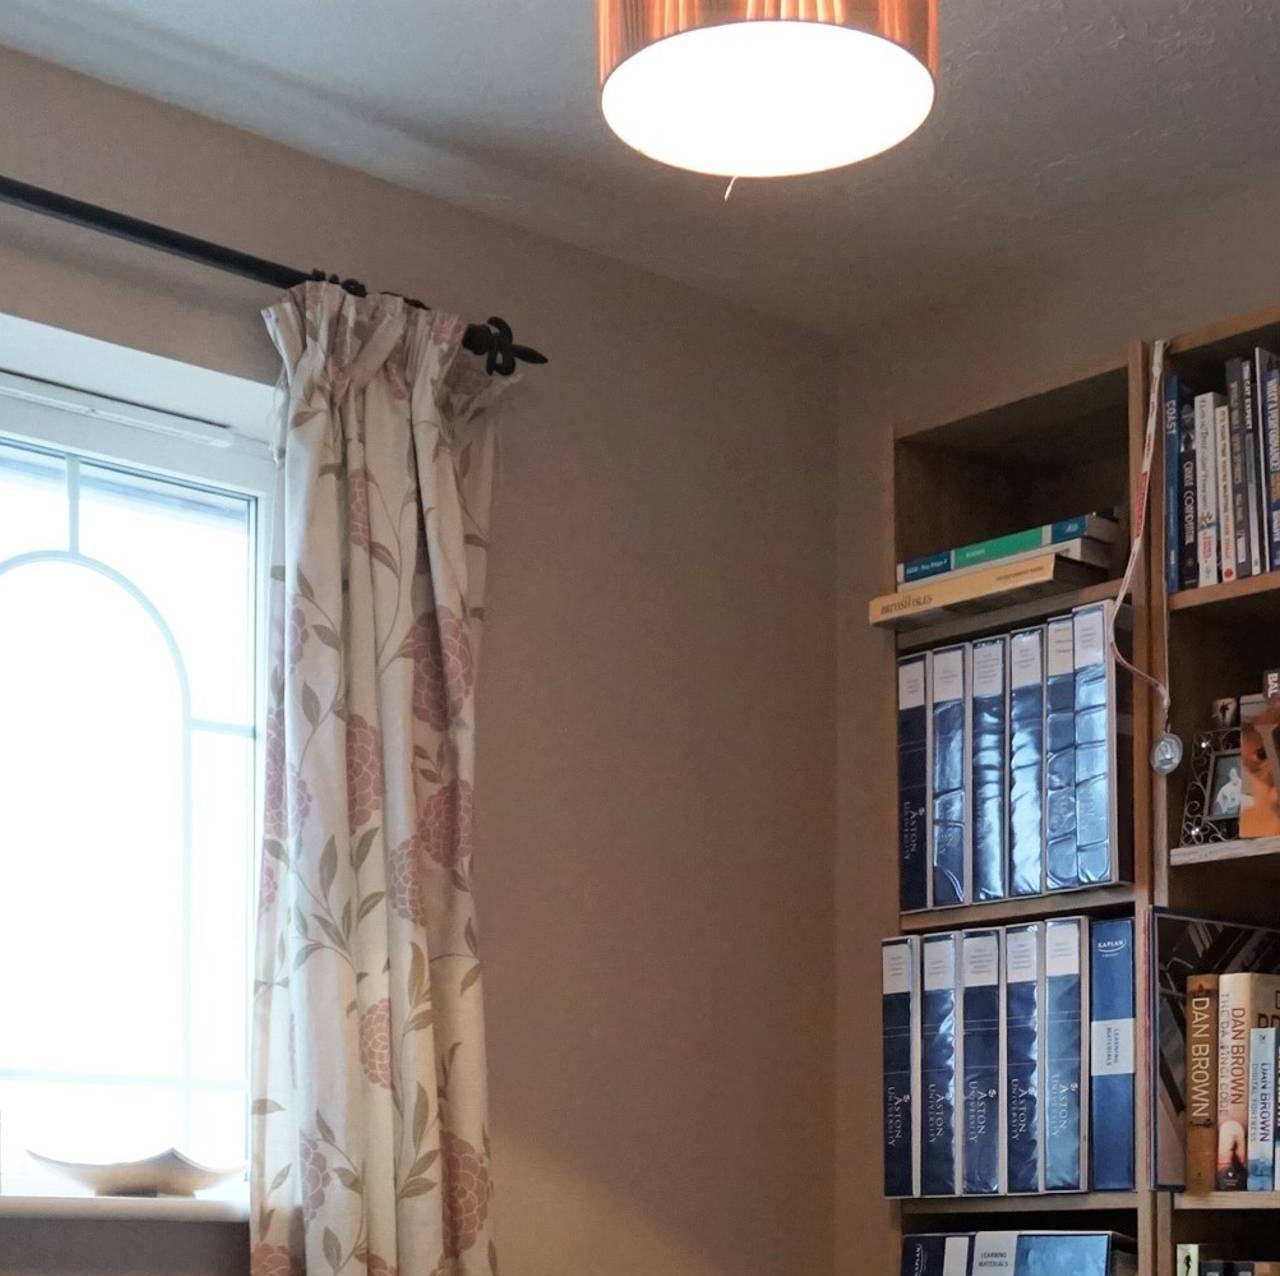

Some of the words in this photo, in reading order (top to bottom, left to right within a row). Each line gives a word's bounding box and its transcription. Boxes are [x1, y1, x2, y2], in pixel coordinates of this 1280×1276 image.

[1244, 380, 1252, 396] CAT
[1166, 399, 1178, 435] COAST
[1245, 398, 1253, 430] EXPERT
[1192, 996, 1210, 1041] DAN
[1230, 1007, 1246, 1041] DAN
[1192, 1043, 1210, 1118] BROWN
[1230, 1045, 1246, 1105] BROWN
[894, 1095, 903, 1140] ASTON
[935, 1093, 944, 1138] ASTON
[976, 1089, 987, 1135] ASTON
[1010, 1078, 1018, 1142] UNIVERSITY
[1017, 1087, 1026, 1134] ASTON
[1059, 1084, 1068, 1130] ASTON
[1259, 1092, 1272, 1143] BROWN
